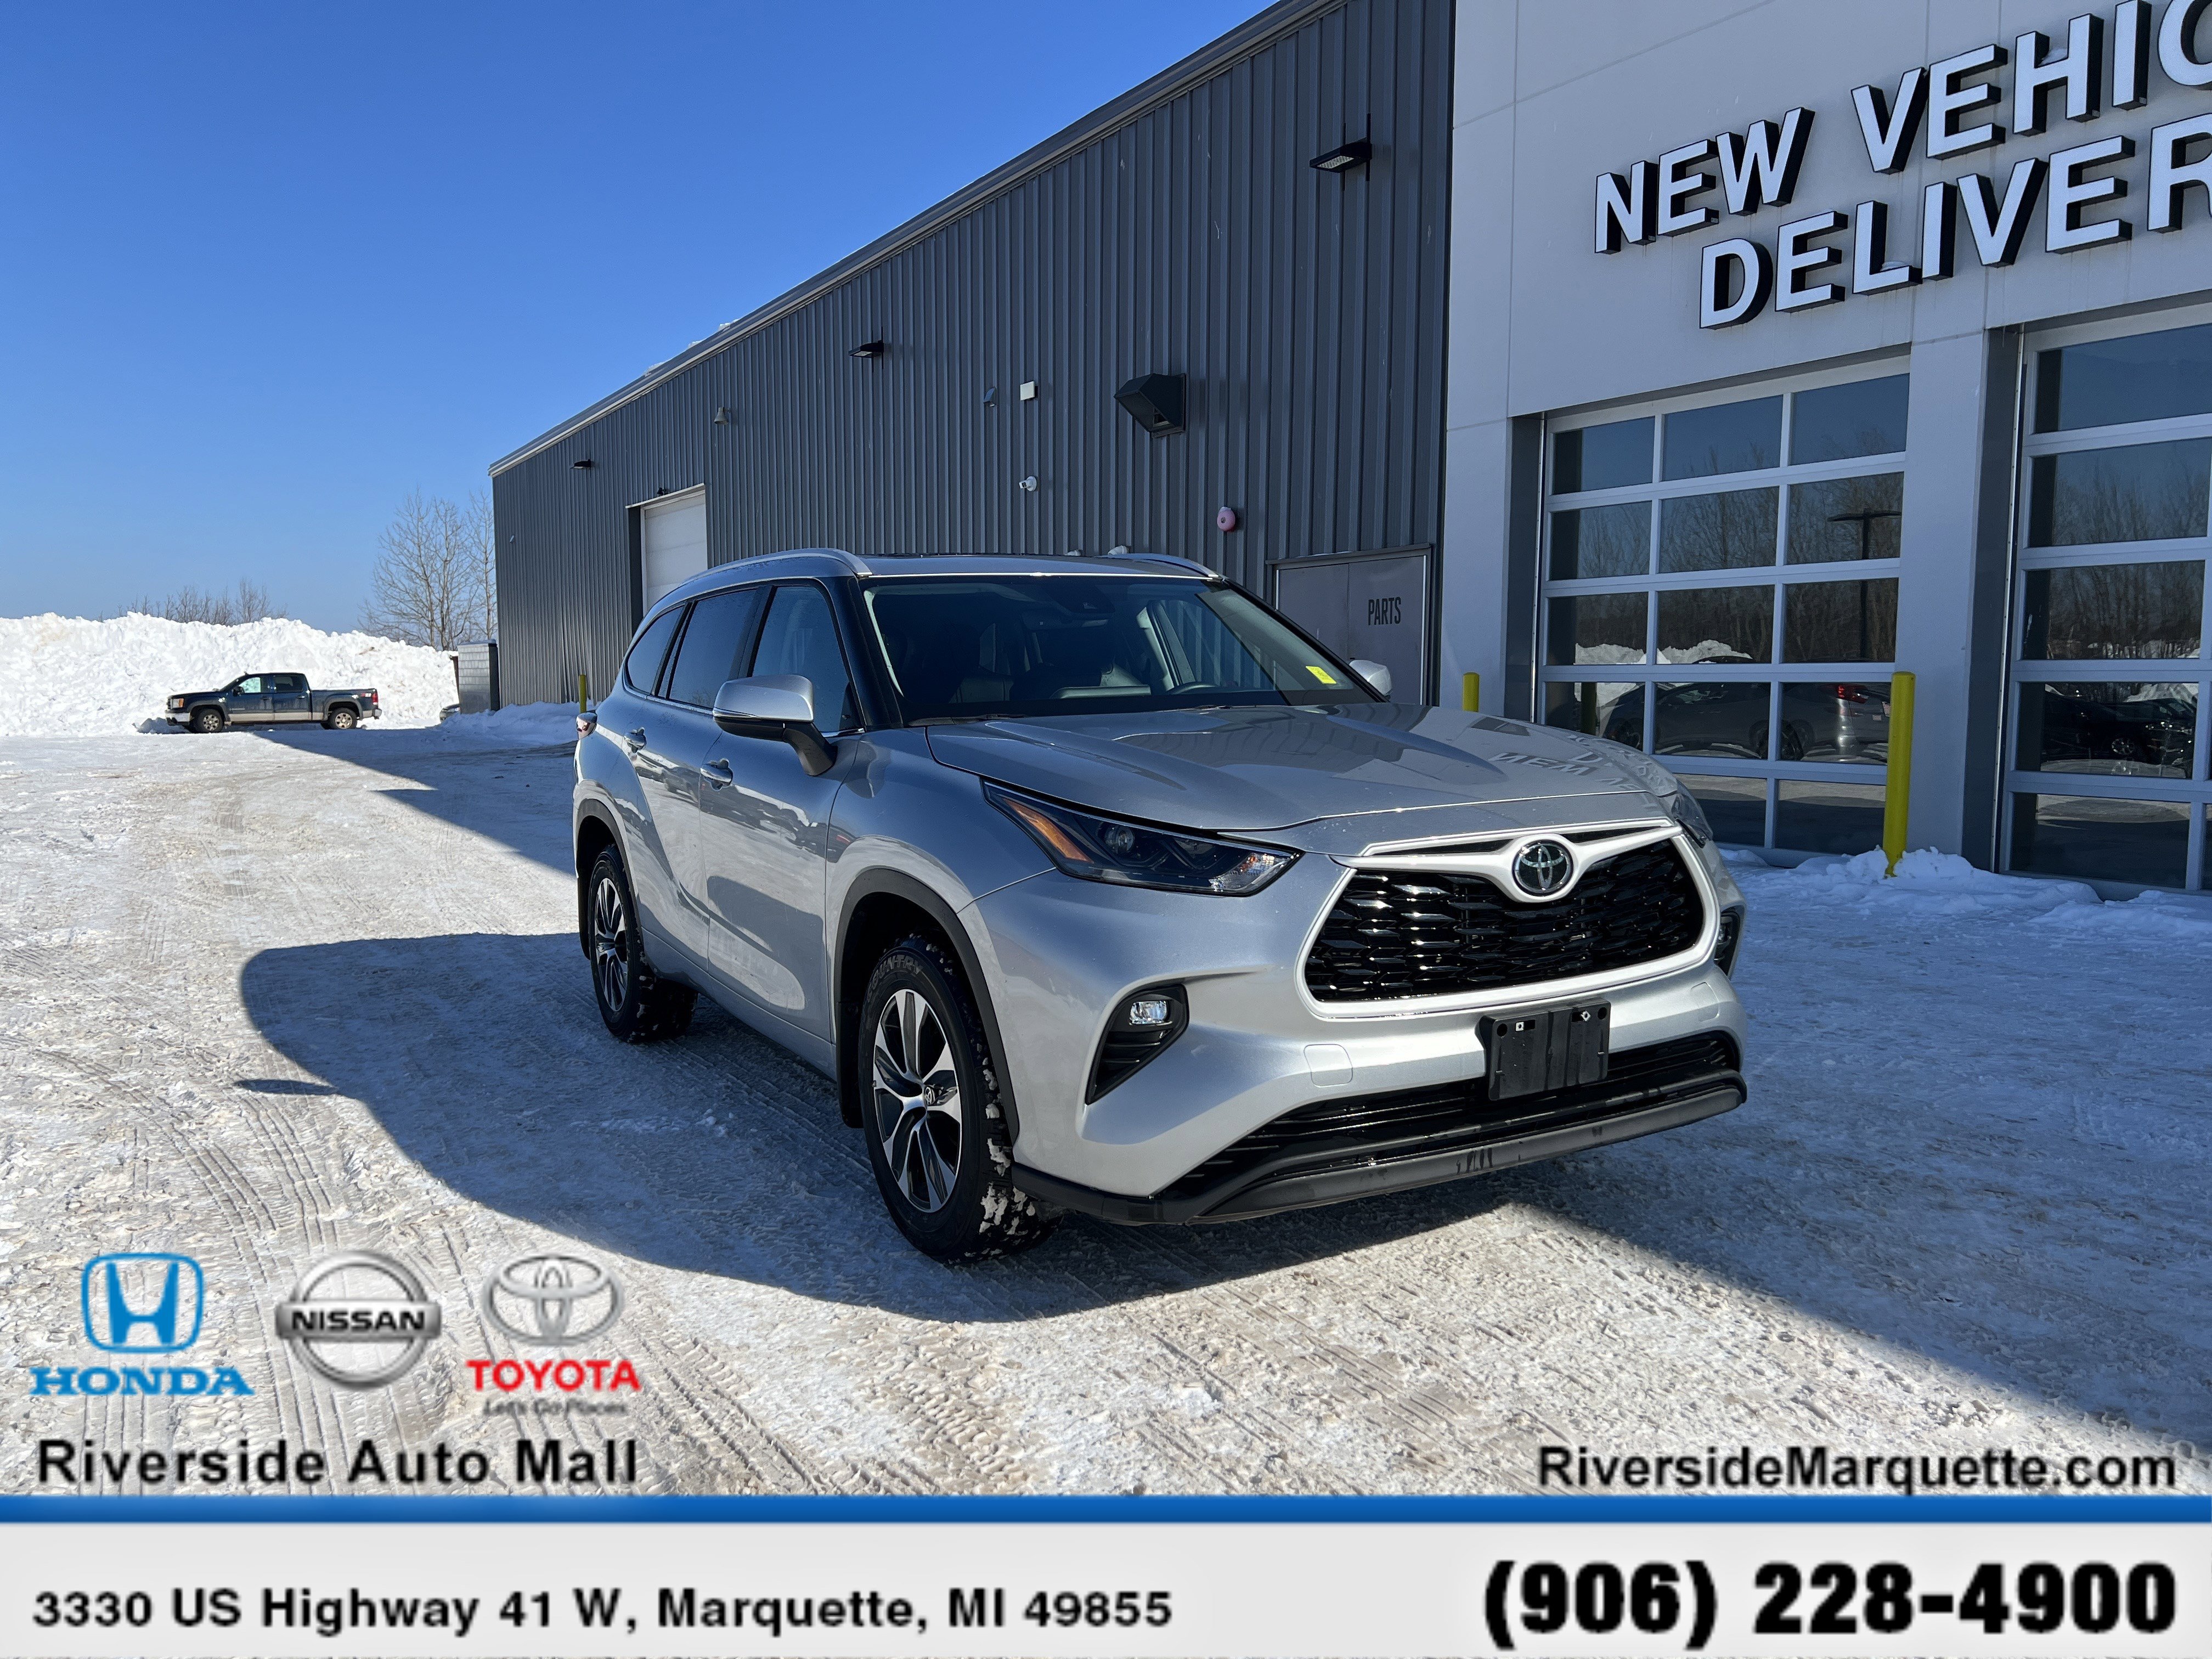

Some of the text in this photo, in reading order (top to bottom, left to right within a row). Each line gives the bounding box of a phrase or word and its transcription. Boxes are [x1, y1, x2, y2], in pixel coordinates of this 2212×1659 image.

[1595, 107, 1815, 255] NEW
[1700, 113, 2212, 330] DELIVER
[1368, 596, 1401, 626] PARTS
